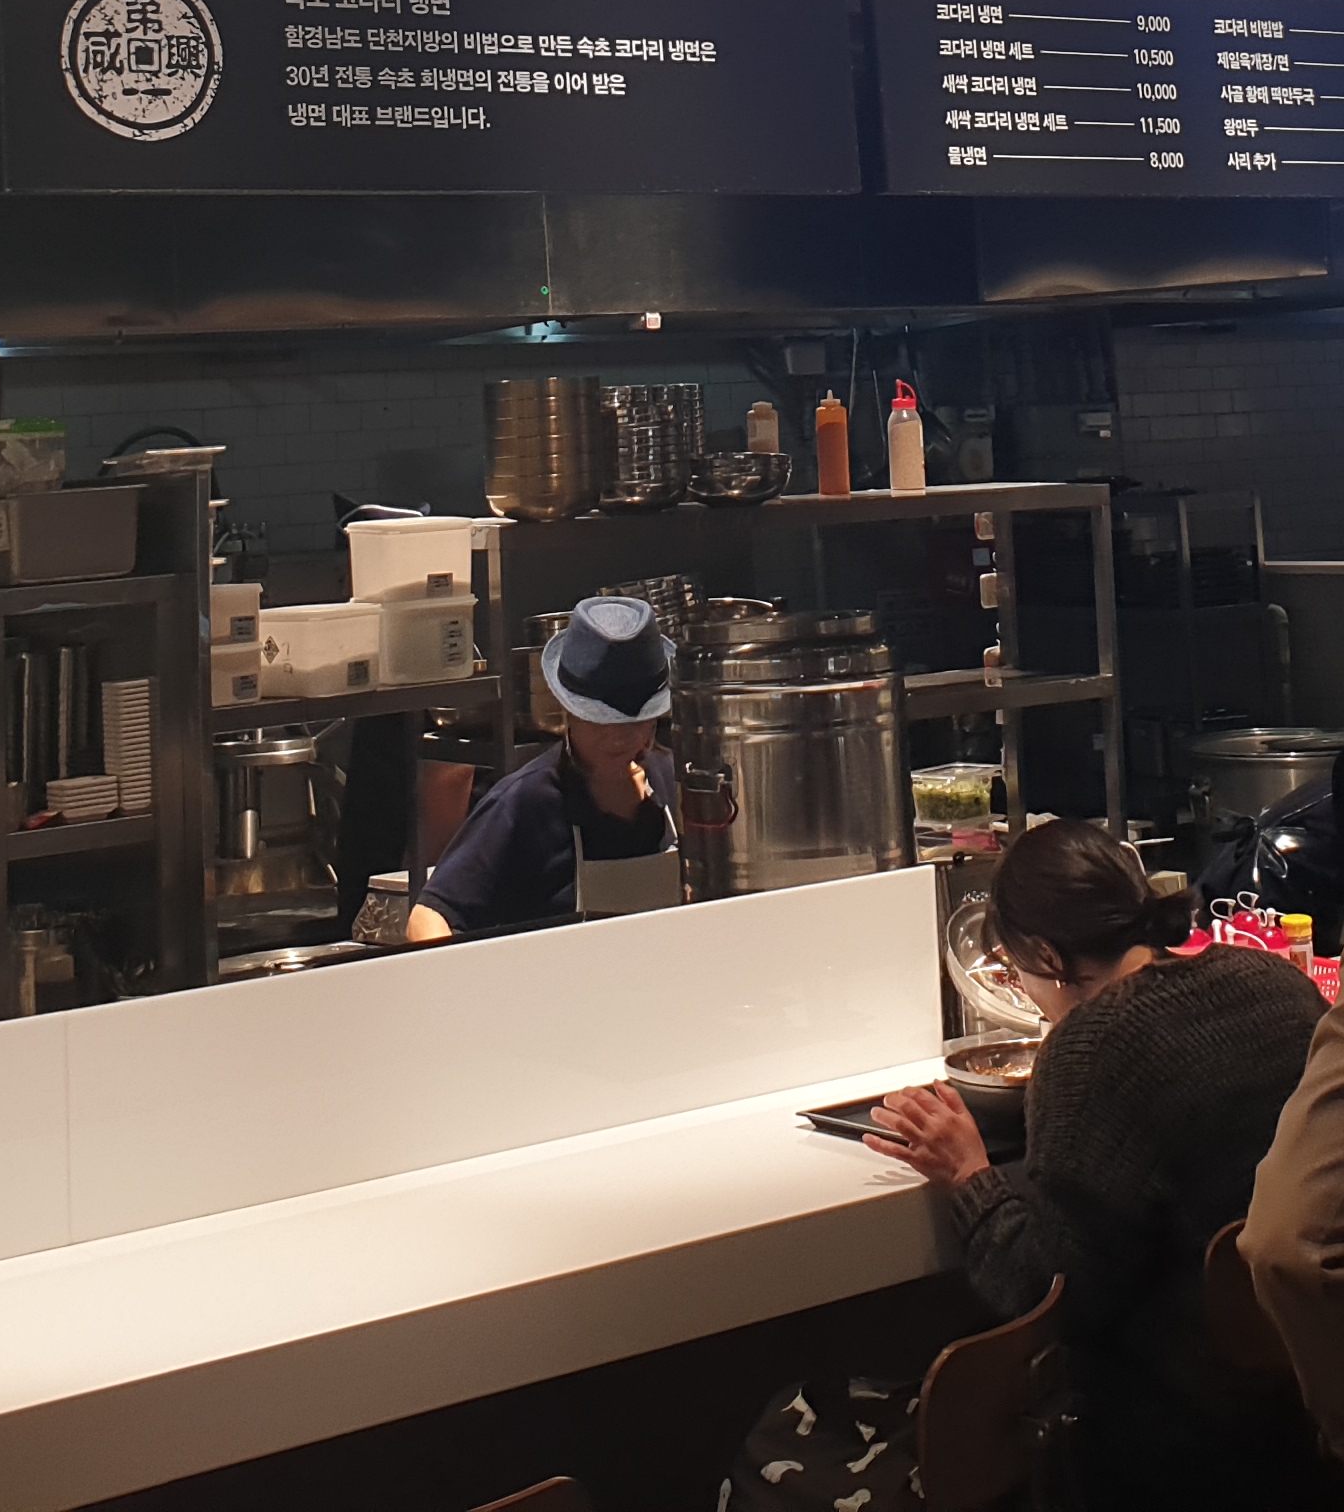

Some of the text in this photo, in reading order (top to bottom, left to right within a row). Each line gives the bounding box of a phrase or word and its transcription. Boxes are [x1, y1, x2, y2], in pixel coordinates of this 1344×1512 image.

[937, 3, 1170, 32] 코다리 냉면 9,000
[1214, 19, 1247, 37] 코다리
[1250, 20, 1283, 38] 비빔밥
[285, 25, 716, 61] 함경남도 단천지방의 비법으로 만든 속초 코다리 냉면은
[940, 39, 1173, 67] 코다리 냉면 세트 10,500
[1217, 52, 1289, 71] 제일육개장/면
[286, 65, 626, 94] 30년 전통 속초 회냉면의 전통을 이어 받은
[943, 74, 1176, 101] 새싹 코다리 냉면 10,000
[1221, 85, 1243, 102] 사골
[1246, 86, 1268, 104] 황태
[1271, 87, 1314, 105] 떡만두국
[289, 103, 490, 129] 냉면 대표 브랜드입니다.
[946, 110, 1180, 135] 새싹 코다리 냉면 세트 11,500
[1224, 118, 1258, 137] 왕만두
[948, 146, 1183, 169] 물냉면 8,000
[1228, 152, 1251, 170] 사리
[1253, 153, 1276, 170] 추가
